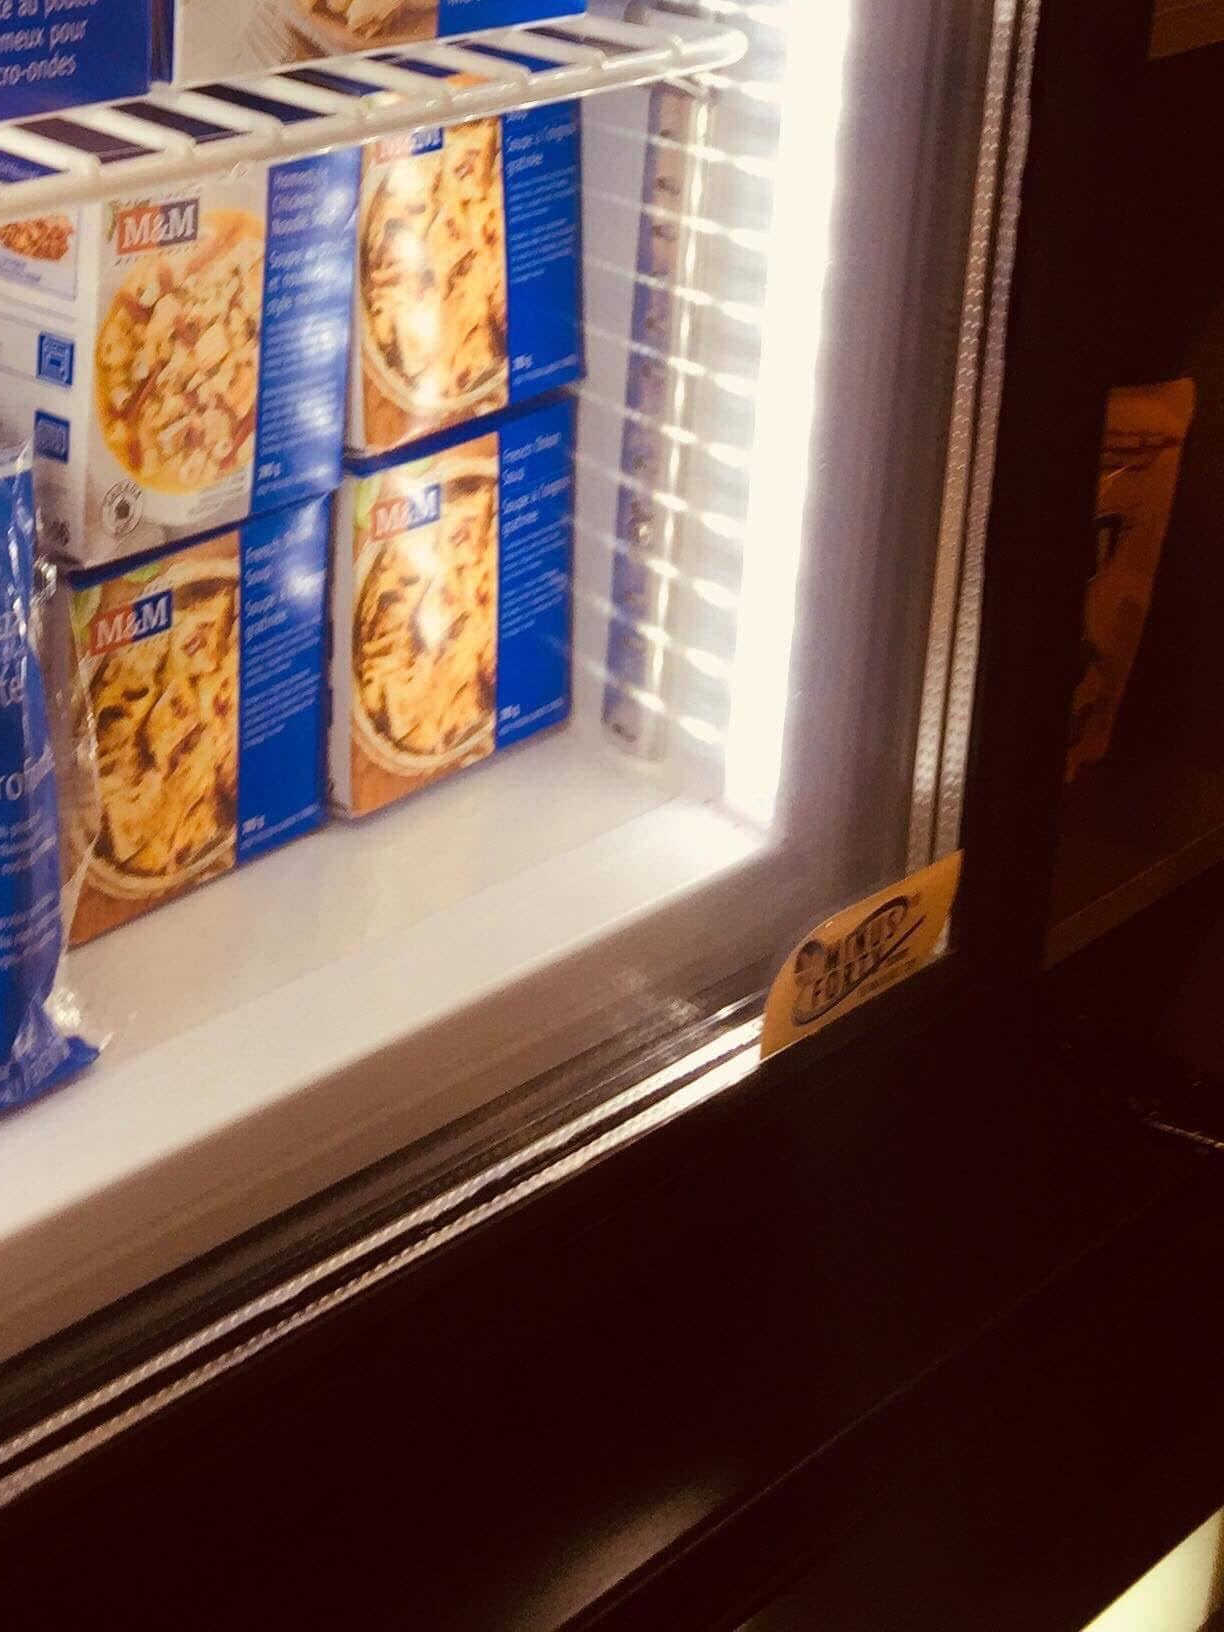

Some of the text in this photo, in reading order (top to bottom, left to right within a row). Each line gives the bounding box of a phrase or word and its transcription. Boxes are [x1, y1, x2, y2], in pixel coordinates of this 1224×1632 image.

[49, 18, 89, 51] pour
[122, 204, 196, 249] M&M
[95, 595, 169, 650] M&M
